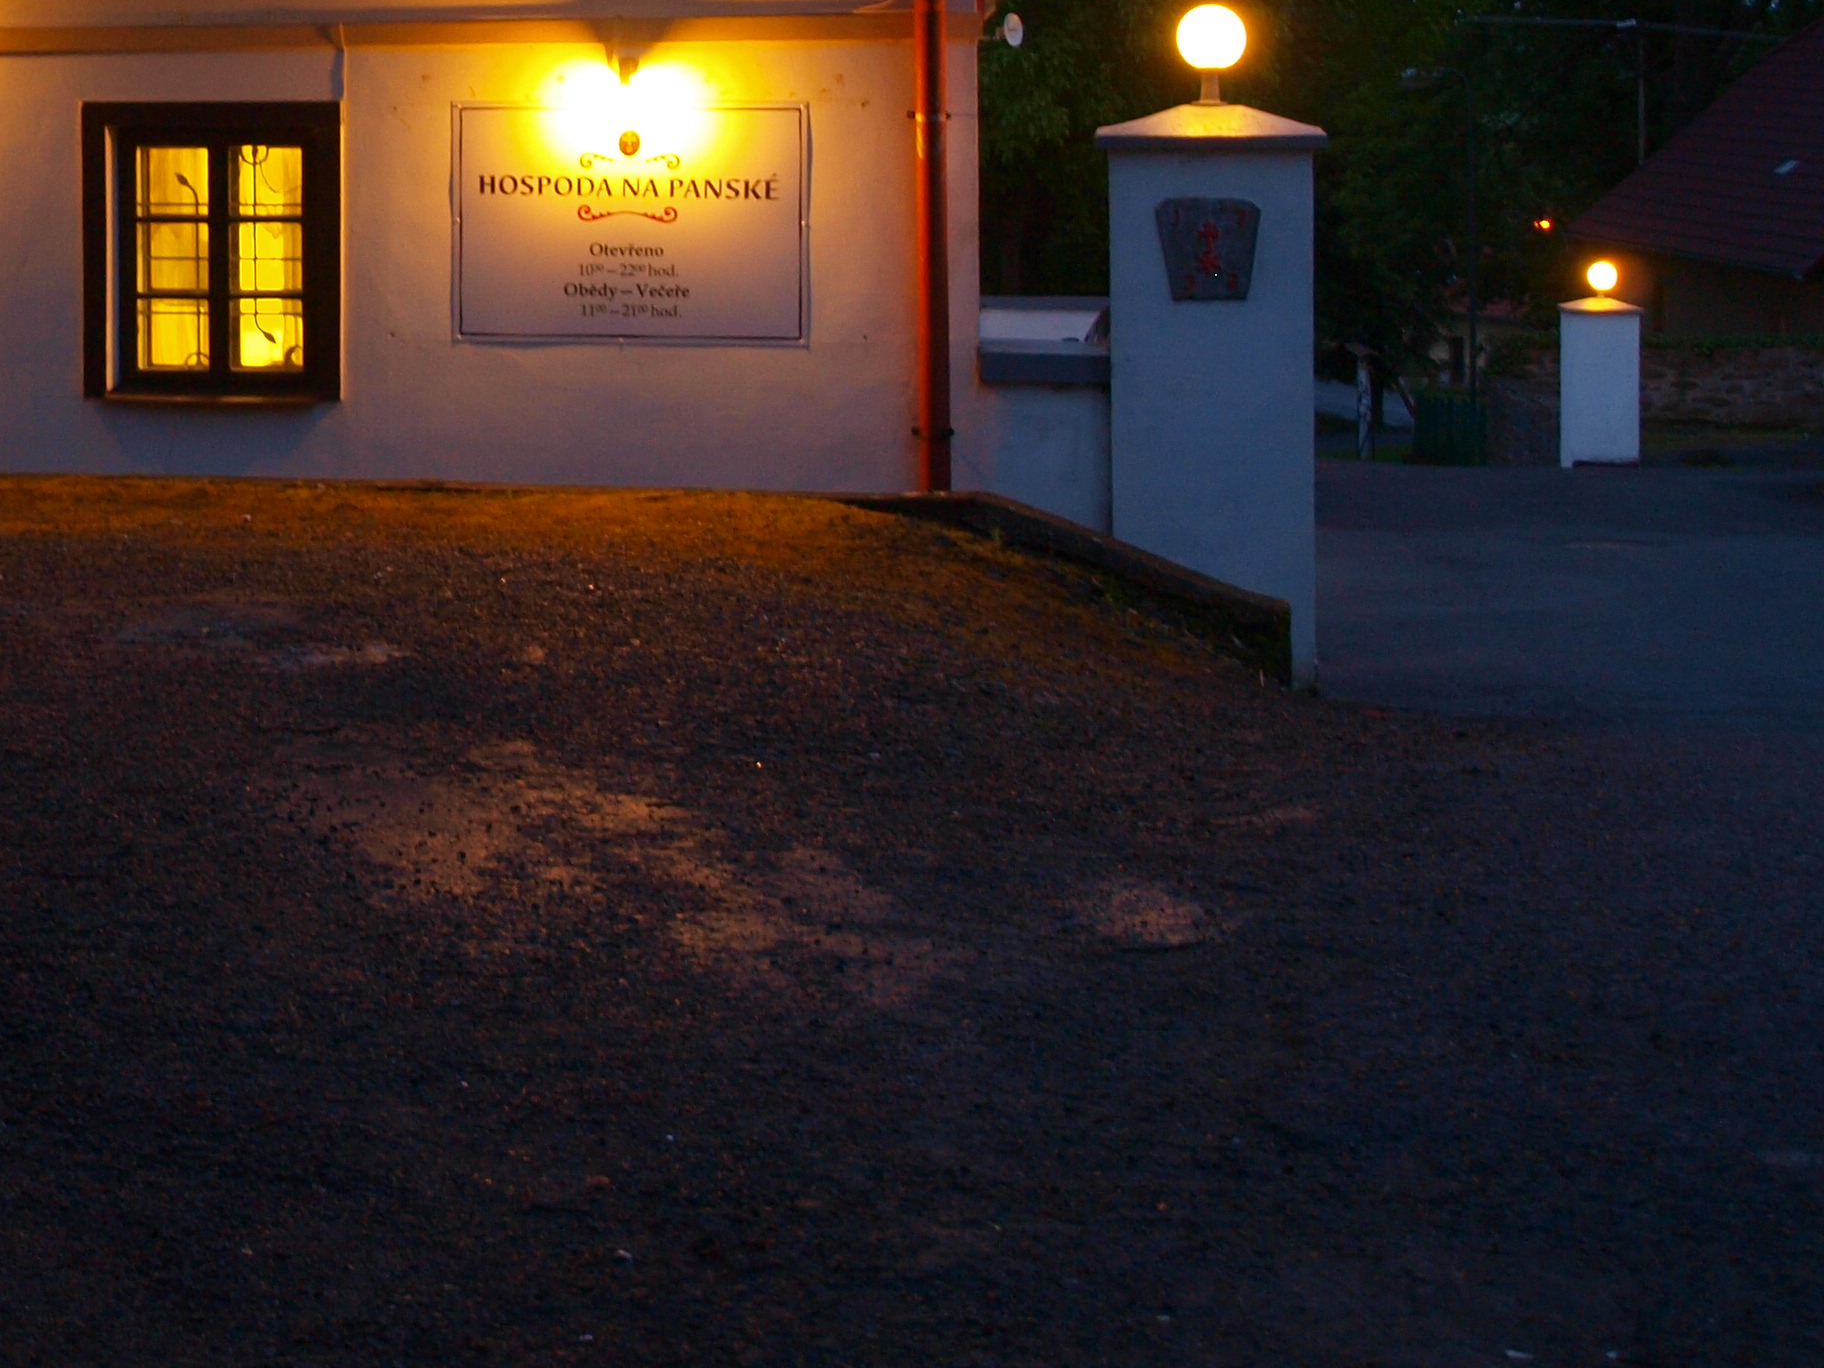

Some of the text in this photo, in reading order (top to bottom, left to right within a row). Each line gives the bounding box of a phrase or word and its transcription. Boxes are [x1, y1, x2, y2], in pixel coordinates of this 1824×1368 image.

[479, 173, 780, 200] HOSPODA NA PANSKÉ
[589, 242, 664, 257] Otevřeno
[564, 282, 616, 302] Obědy
[636, 282, 690, 298] Večeře
